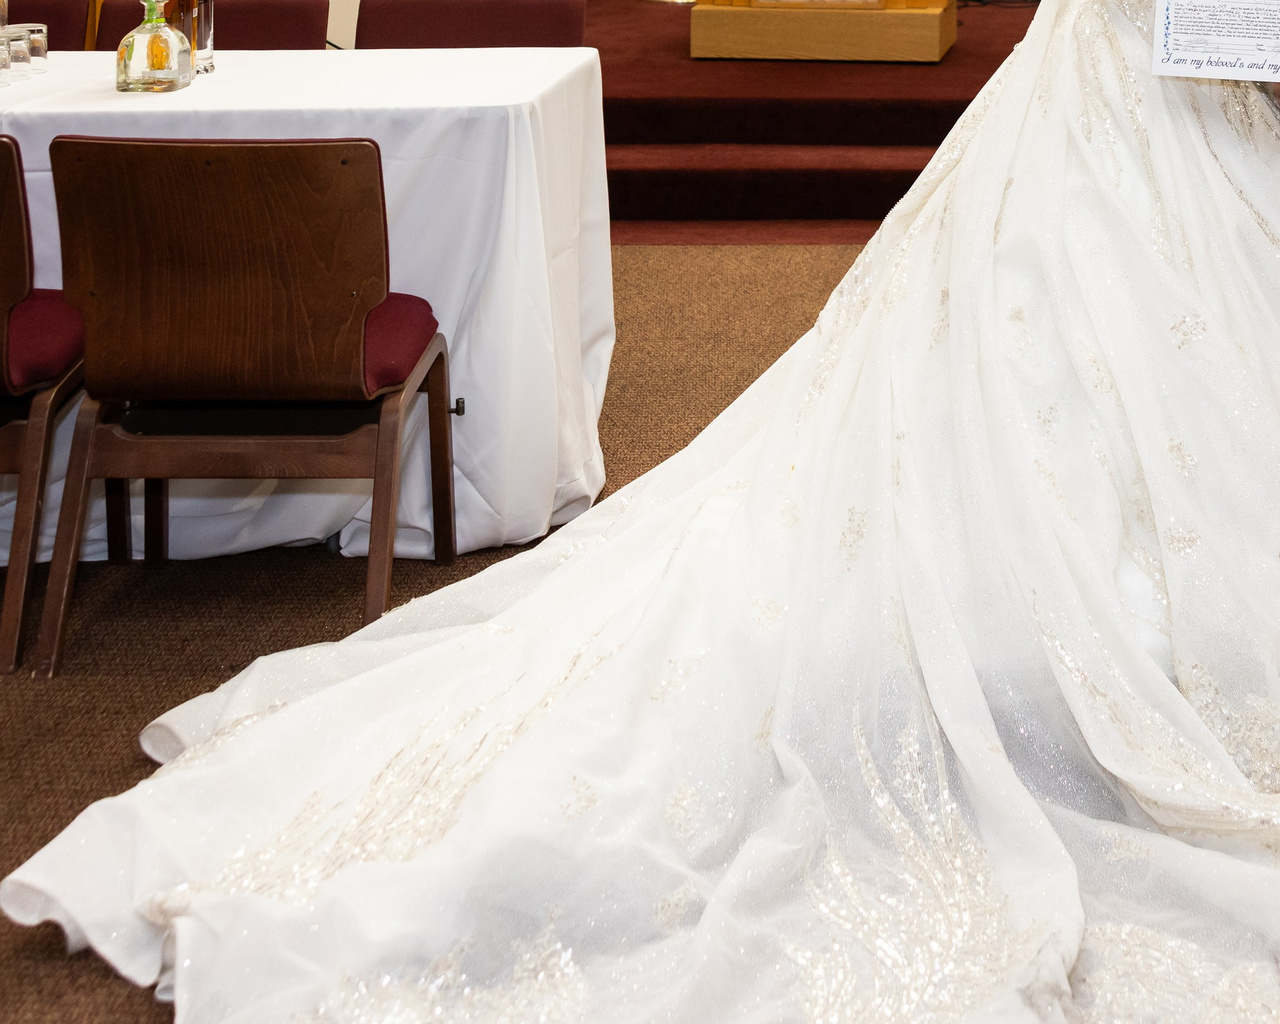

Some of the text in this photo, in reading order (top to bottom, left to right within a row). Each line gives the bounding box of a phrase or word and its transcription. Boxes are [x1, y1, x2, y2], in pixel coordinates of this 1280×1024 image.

[1161, 51, 1173, 64] I
[1189, 58, 1204, 70] my
[1206, 56, 1245, 69] beloved's
[1247, 59, 1267, 70] and
[1267, 63, 1280, 74] my
